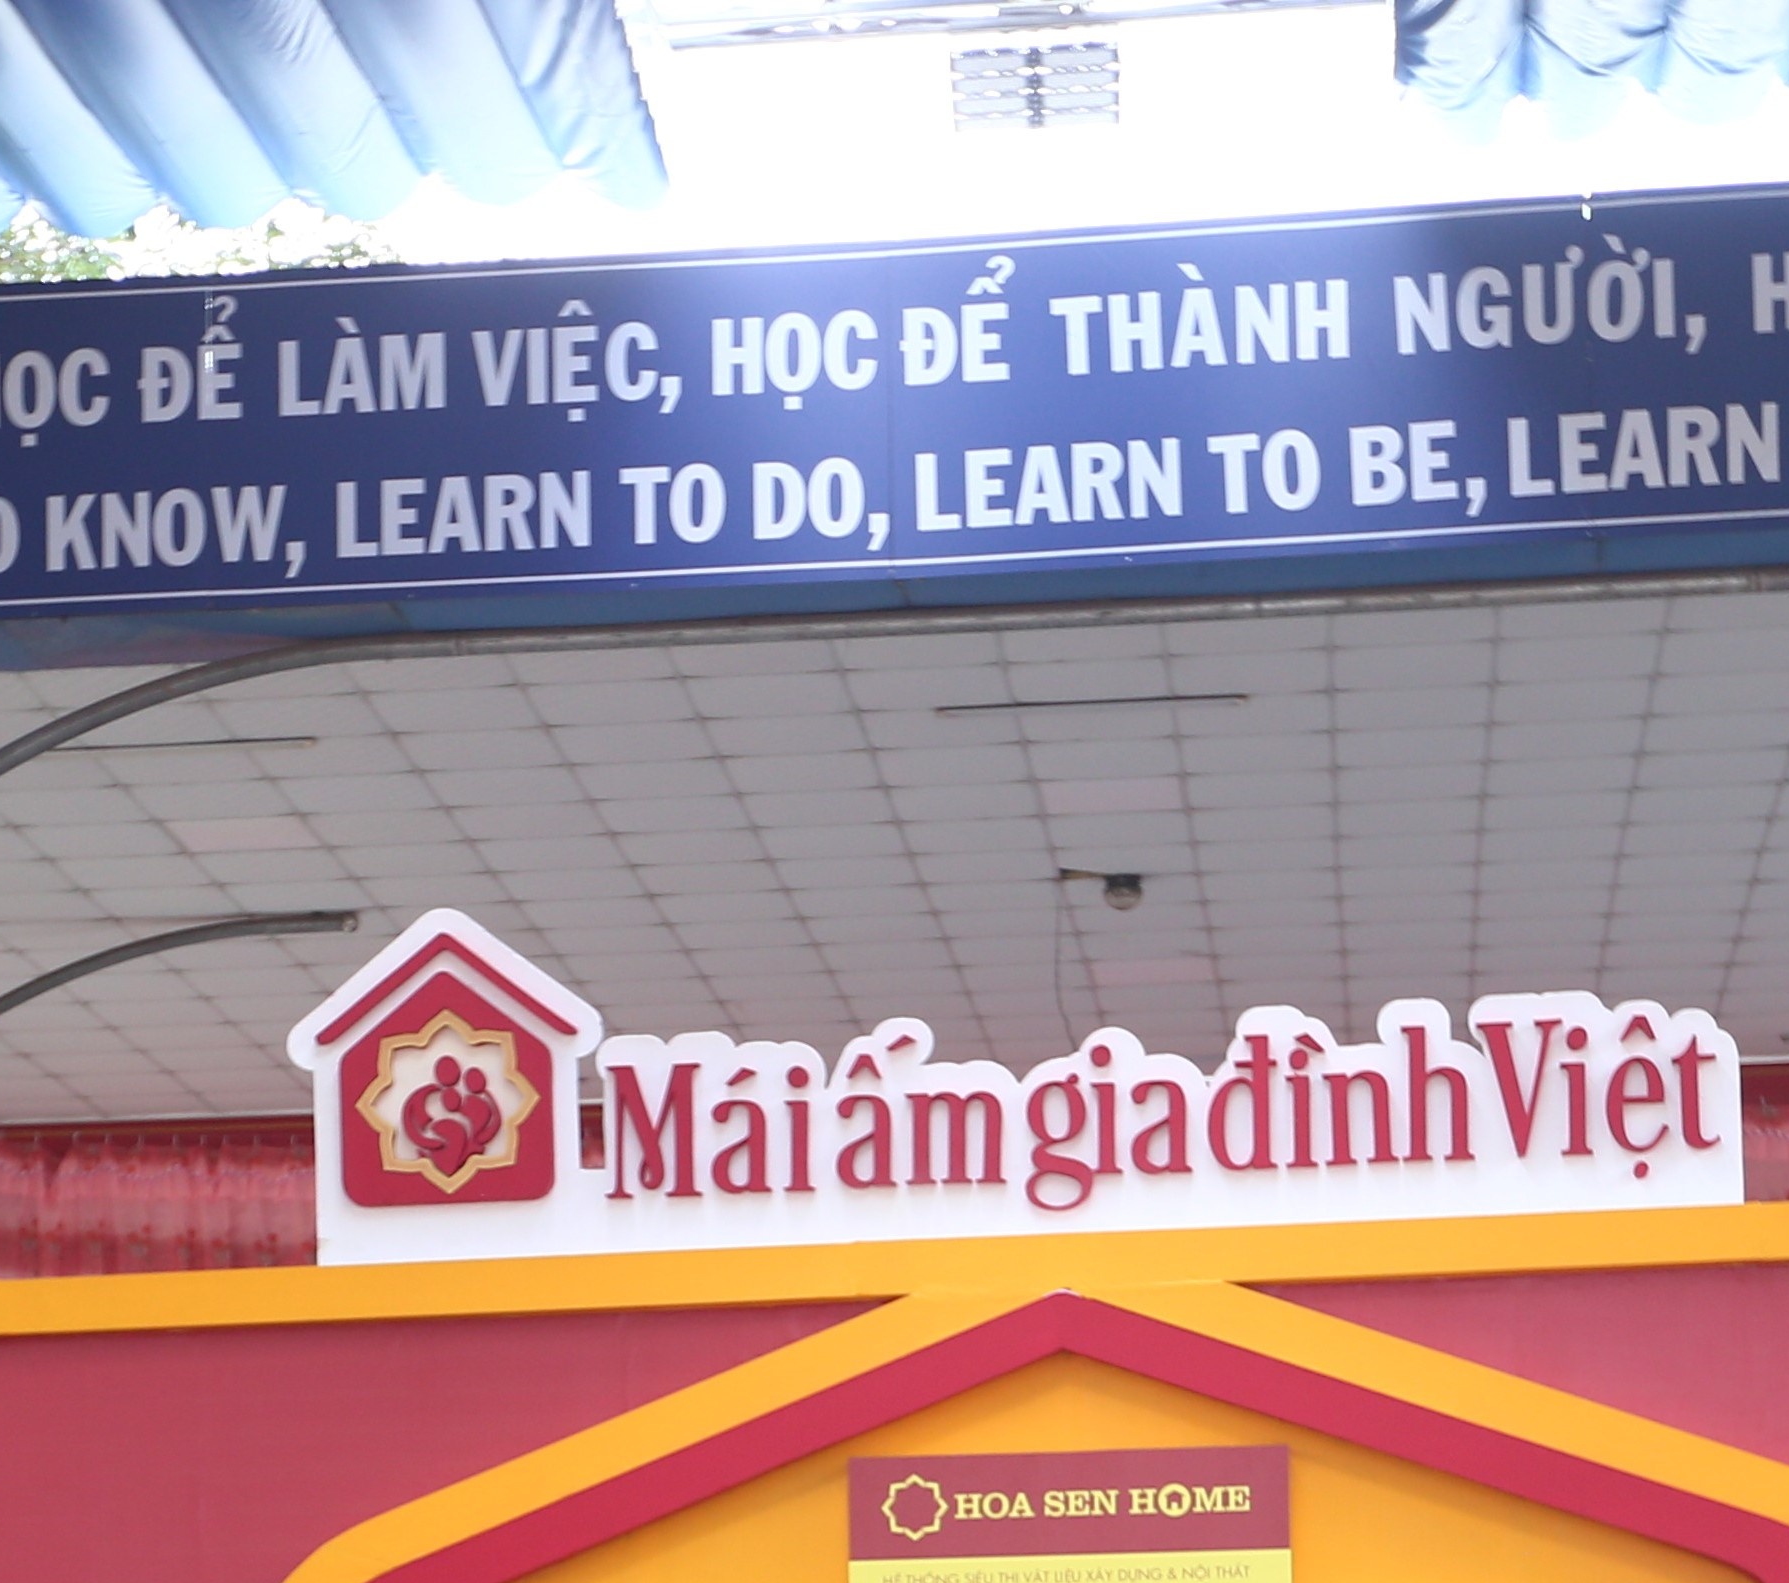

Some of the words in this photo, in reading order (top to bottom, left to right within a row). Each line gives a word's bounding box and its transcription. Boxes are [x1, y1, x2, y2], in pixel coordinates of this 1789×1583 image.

[139, 296, 243, 423] ĐỂ
[278, 315, 443, 419] LÀM
[472, 299, 682, 421] VIỆC,
[712, 307, 876, 409] HỌC
[901, 255, 1014, 386] ĐỂ
[1050, 261, 1350, 374] THÀNH
[1395, 234, 1707, 357] NGƯỜI,
[46, 483, 308, 583] KNOW,
[337, 466, 589, 561] LEARN
[620, 460, 726, 545] TO
[751, 455, 891, 555] DO,
[912, 441, 1183, 534] LEARN
[1207, 430, 1320, 515] TO
[1350, 417, 1488, 520] BE,
[1506, 401, 1779, 497] LEARN
[605, 1062, 815, 1201] Mái
[837, 1031, 1007, 1187] ấm
[1025, 1043, 1193, 1213] gia
[1210, 1023, 1475, 1172] đình
[1473, 1015, 1723, 1179] Việt
[954, 1491, 1035, 1519] HOA
[1043, 1489, 1119, 1518] SEN
[1128, 1482, 1252, 1518] HOME
